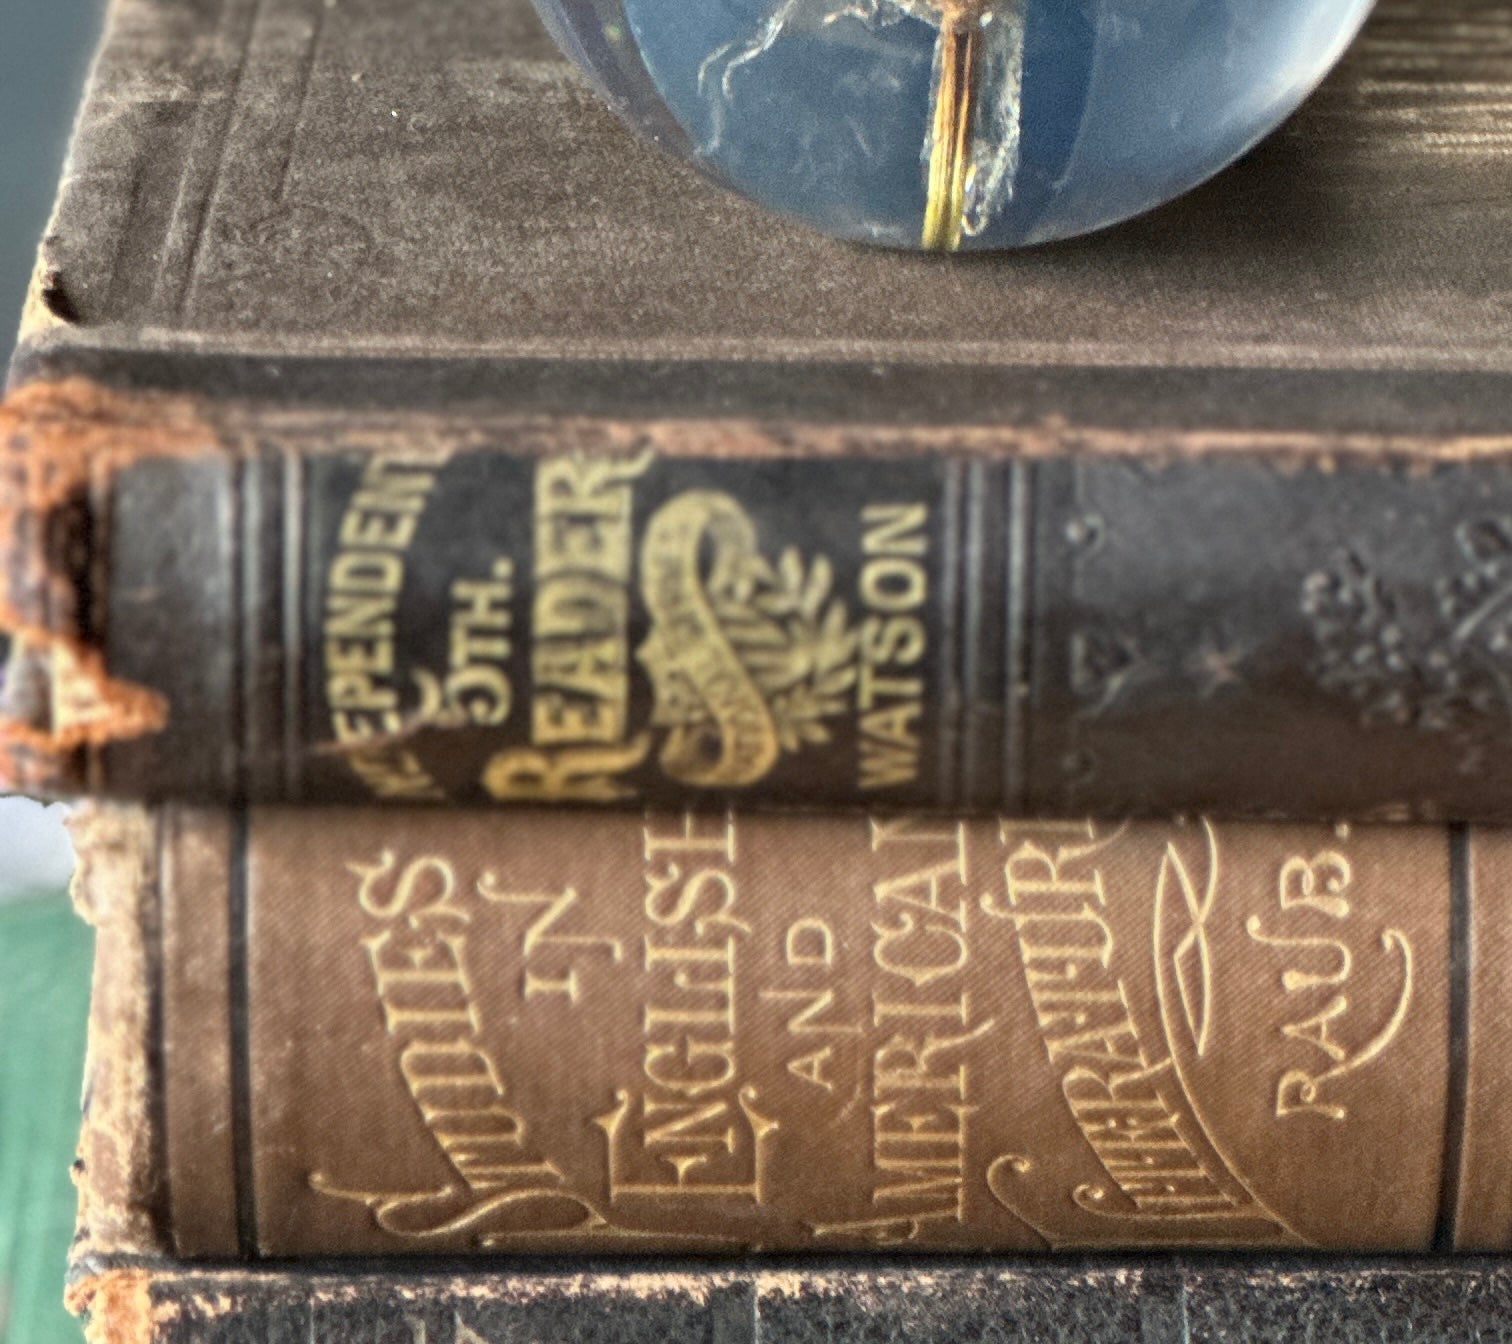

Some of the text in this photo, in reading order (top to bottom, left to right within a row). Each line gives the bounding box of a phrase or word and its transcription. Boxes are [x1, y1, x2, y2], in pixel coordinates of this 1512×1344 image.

[483, 435, 656, 802] READER
[857, 501, 930, 791] WATSON
[306, 848, 608, 1240] STUDIES
[476, 870, 624, 1003] IN
[760, 916, 862, 1094] AND
[1246, 822, 1413, 1120] RAUB.
